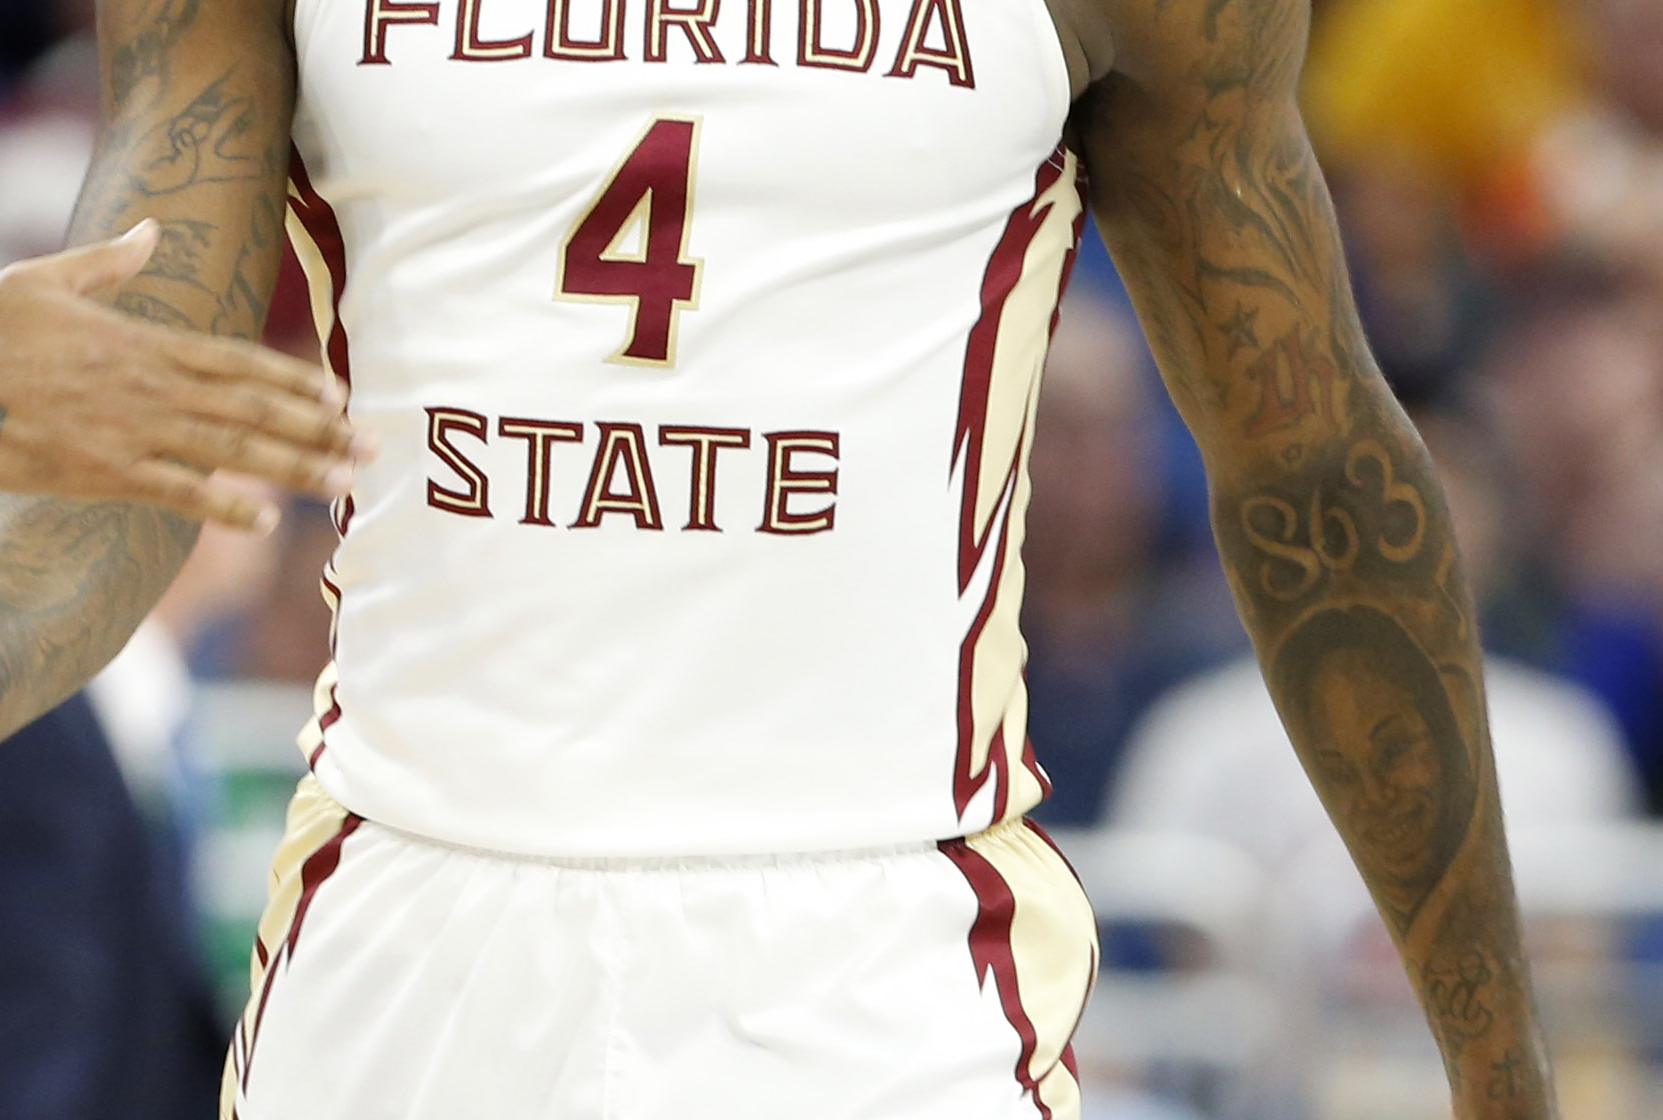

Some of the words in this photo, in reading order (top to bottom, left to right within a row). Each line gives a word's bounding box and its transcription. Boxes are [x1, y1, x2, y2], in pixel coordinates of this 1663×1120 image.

[551, 112, 705, 371] 4
[423, 406, 841, 537] STATE
[1241, 439, 1425, 601] 863
